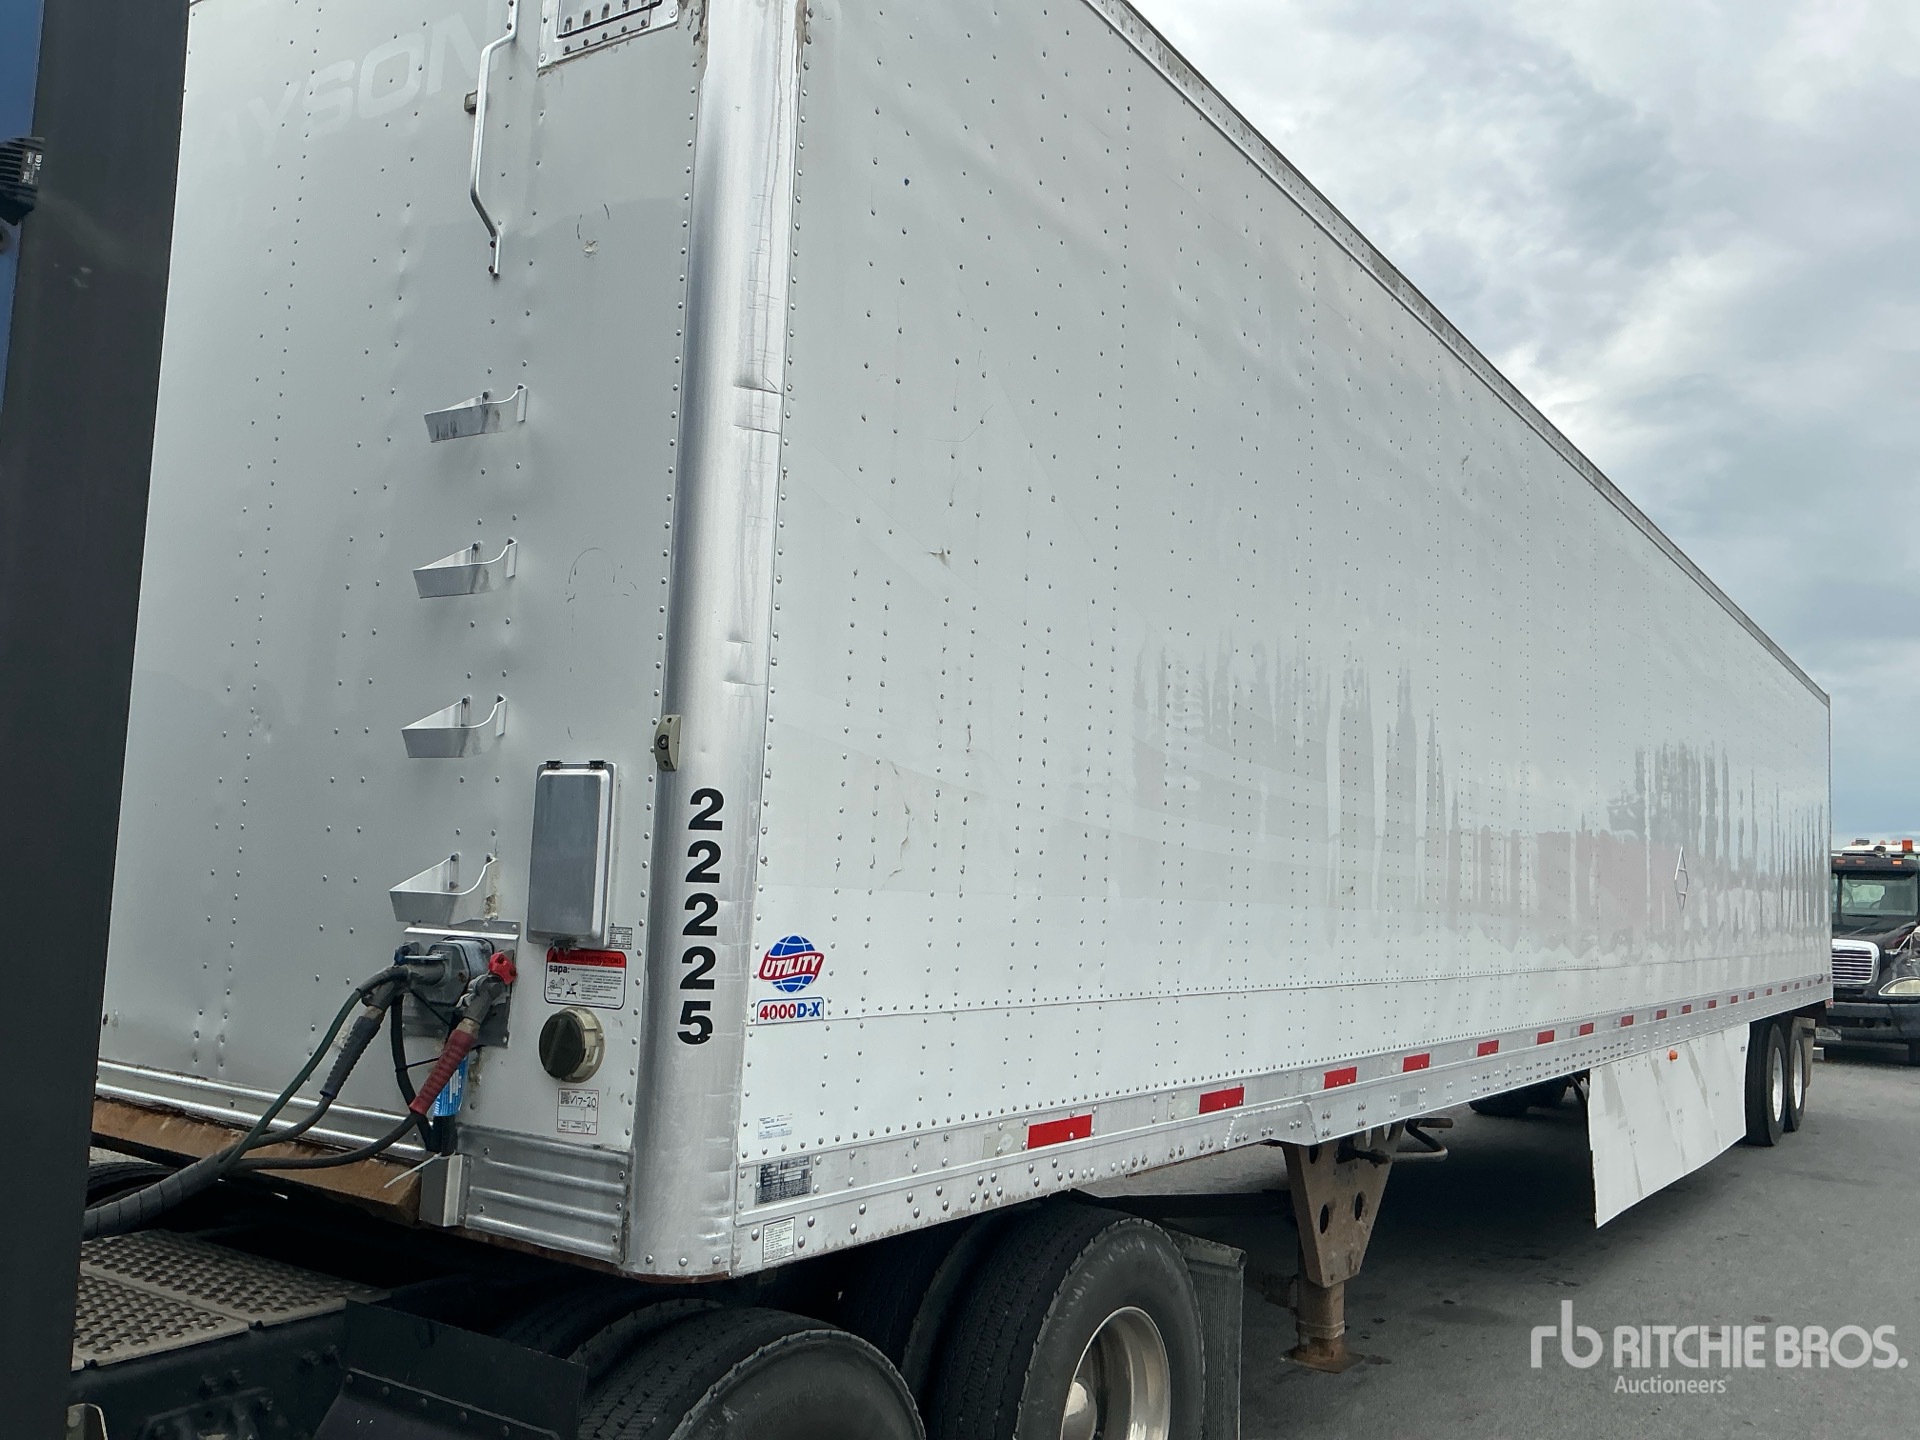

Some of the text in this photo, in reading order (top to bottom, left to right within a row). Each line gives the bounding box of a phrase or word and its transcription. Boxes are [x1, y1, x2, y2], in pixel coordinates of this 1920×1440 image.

[677, 788, 724, 1045] 22225
[763, 955, 821, 977] UTILITY
[760, 1001, 821, 1020] 4000D-X
